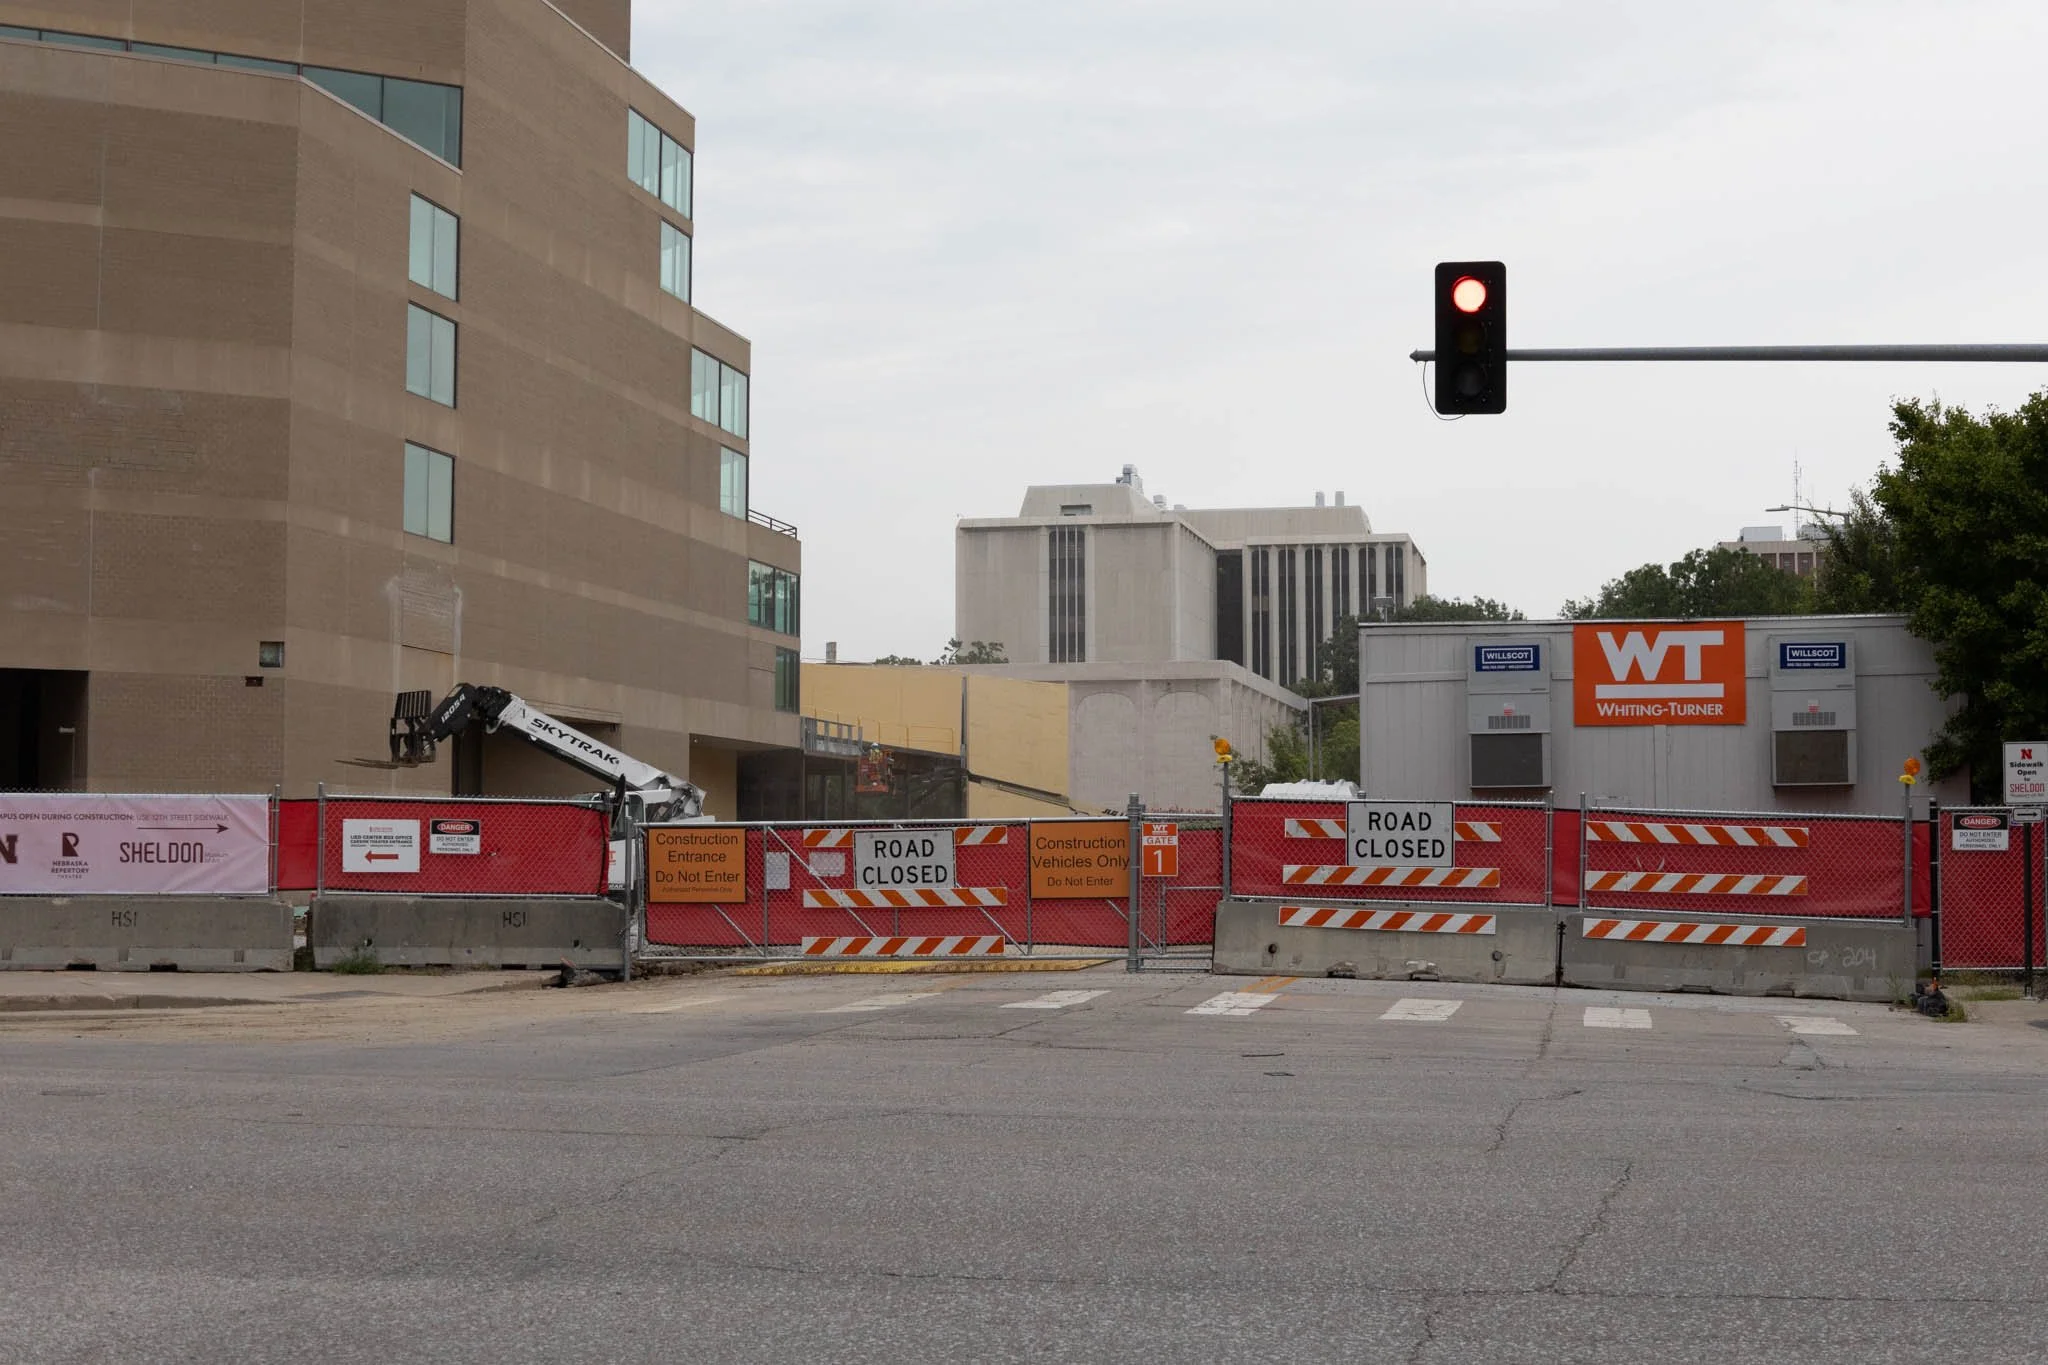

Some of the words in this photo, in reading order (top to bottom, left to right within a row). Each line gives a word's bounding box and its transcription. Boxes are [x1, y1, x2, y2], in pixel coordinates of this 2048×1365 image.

[1486, 652, 1529, 660] WILLSCOT
[1596, 630, 1724, 682] WT
[1791, 649, 1835, 657] WILLSCOT
[1596, 702, 1724, 717] WHITING-TURNER
[530, 717, 618, 765] SKYTRAK
[2020, 749, 2033, 760] N
[2017, 769, 2037, 777] Open
[2009, 783, 2045, 792] SHELDON
[19, 813, 40, 821] OPEN
[42, 813, 72, 821] DURING
[1368, 811, 1432, 831] ROAD
[440, 823, 469, 831] DANGER
[656, 832, 739, 846] Construction
[1147, 836, 1174, 845] GATE
[1982, 831, 2002, 839] ENTER
[62, 832, 80, 857] R
[874, 839, 935, 858] ROAD
[1035, 836, 1125, 850] Construction
[1355, 838, 1445, 858] CLOSED
[119, 842, 204, 863] SHELDON
[668, 850, 727, 863] Entrance
[1031, 855, 1093, 869] Vehicles
[1097, 854, 1130, 871] Only
[1153, 849, 1162, 873] 1
[655, 871, 674, 883] Do
[678, 870, 701, 883] Not
[705, 870, 740, 882] Enter
[862, 865, 947, 885] CLOSED
[1047, 876, 1062, 887] Do
[1065, 876, 1083, 887] Not
[1086, 875, 1114, 887] Enter
[111, 910, 137, 928] HSI
[502, 911, 527, 928] HSI
